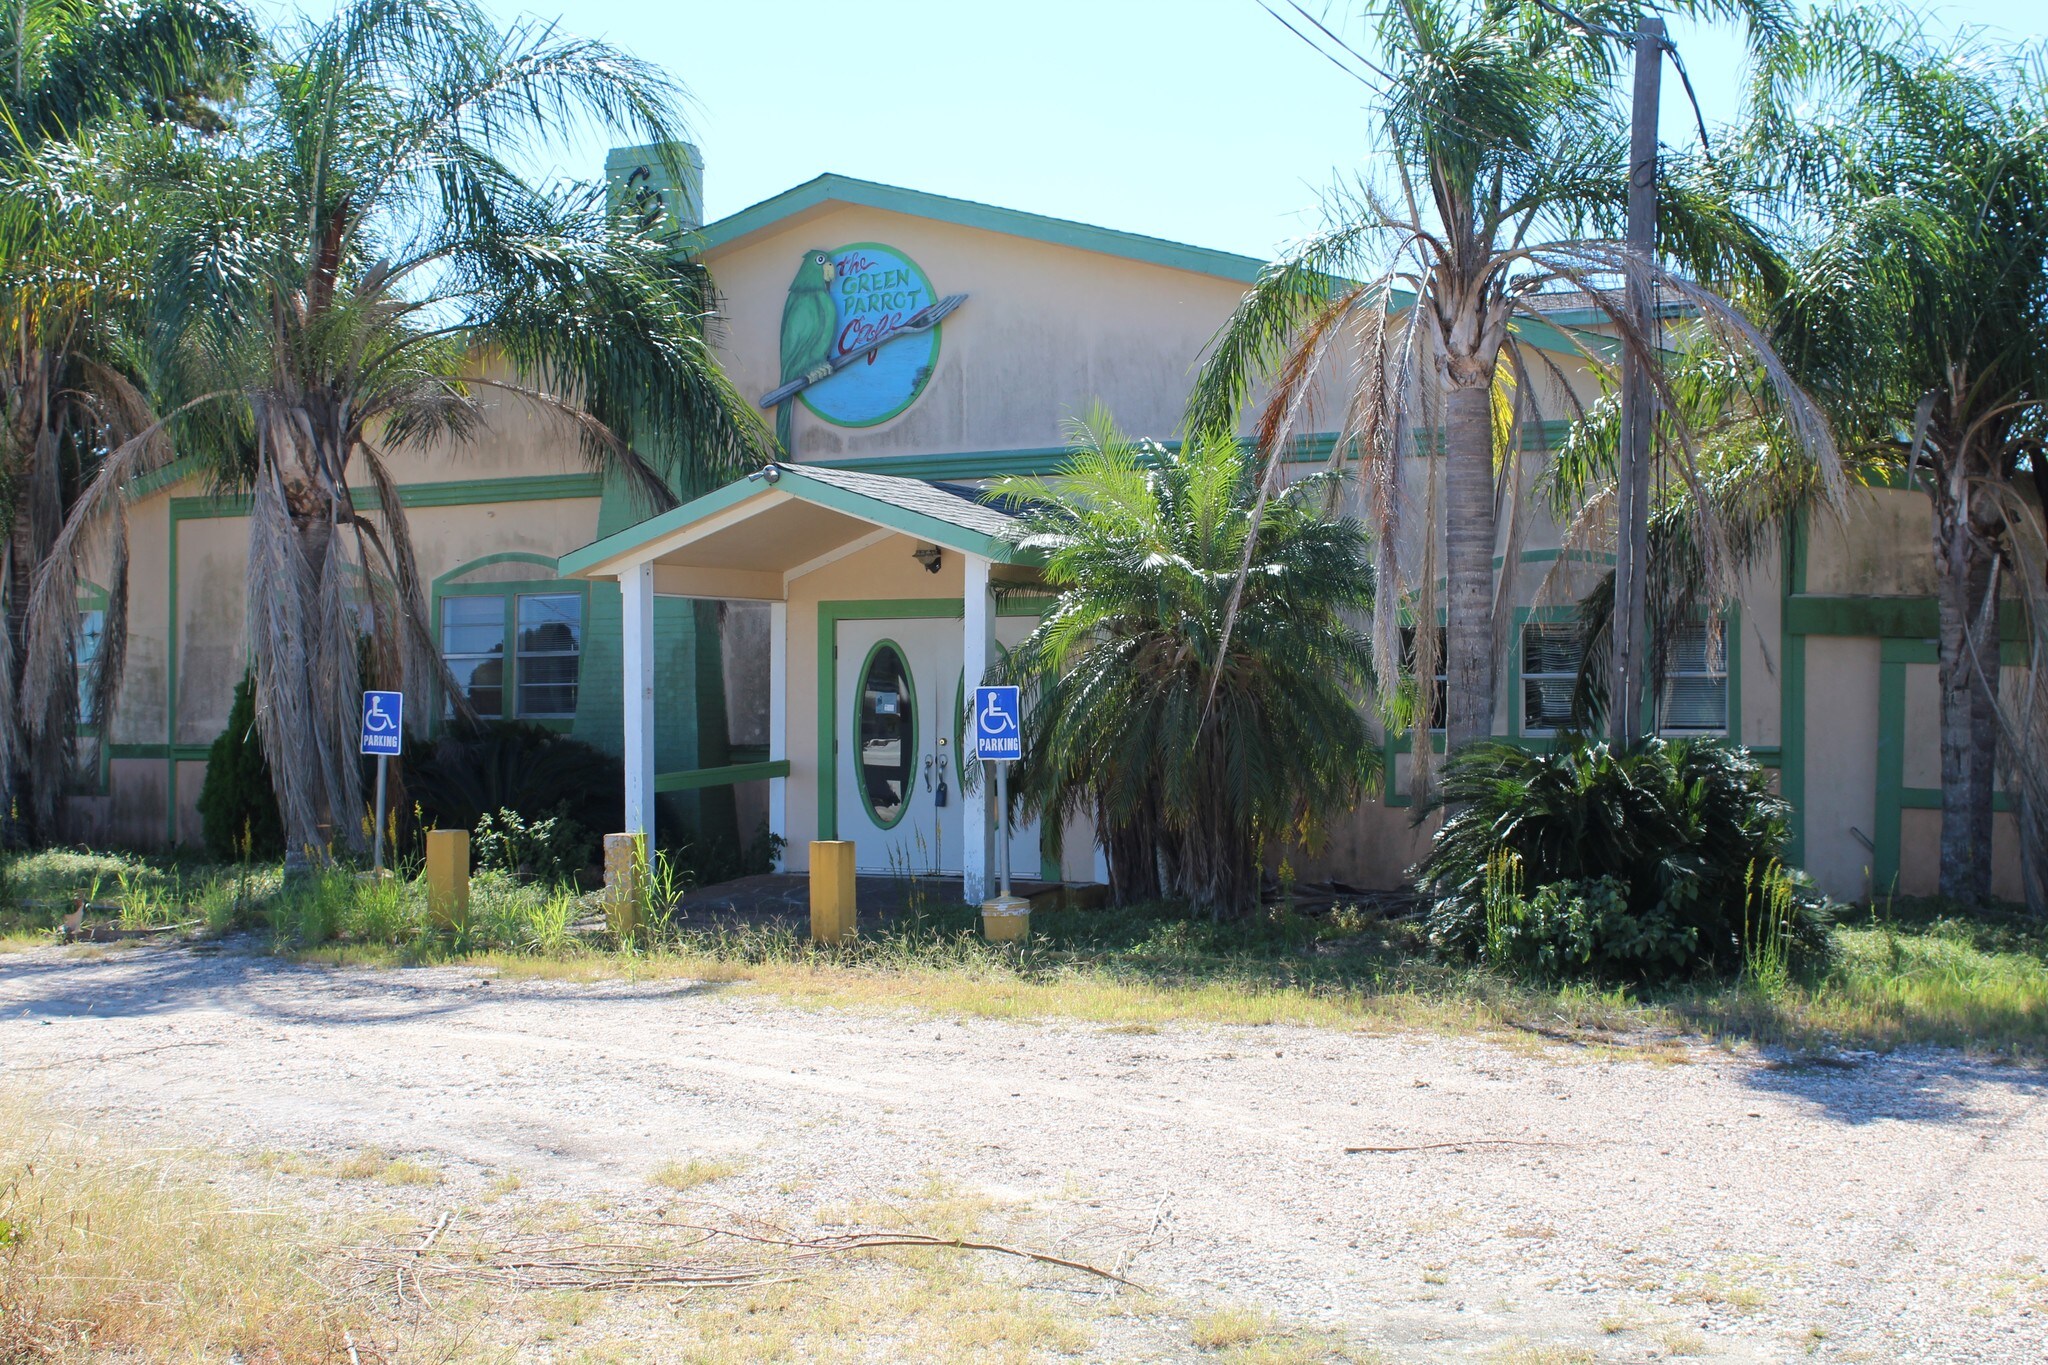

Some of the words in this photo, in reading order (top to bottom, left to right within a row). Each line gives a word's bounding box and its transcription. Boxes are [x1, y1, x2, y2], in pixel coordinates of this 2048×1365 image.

[841, 269, 910, 295] GREEN
[844, 287, 922, 316] PARROT
[363, 734, 398, 748] PARKING
[979, 737, 1019, 752] PARKING
